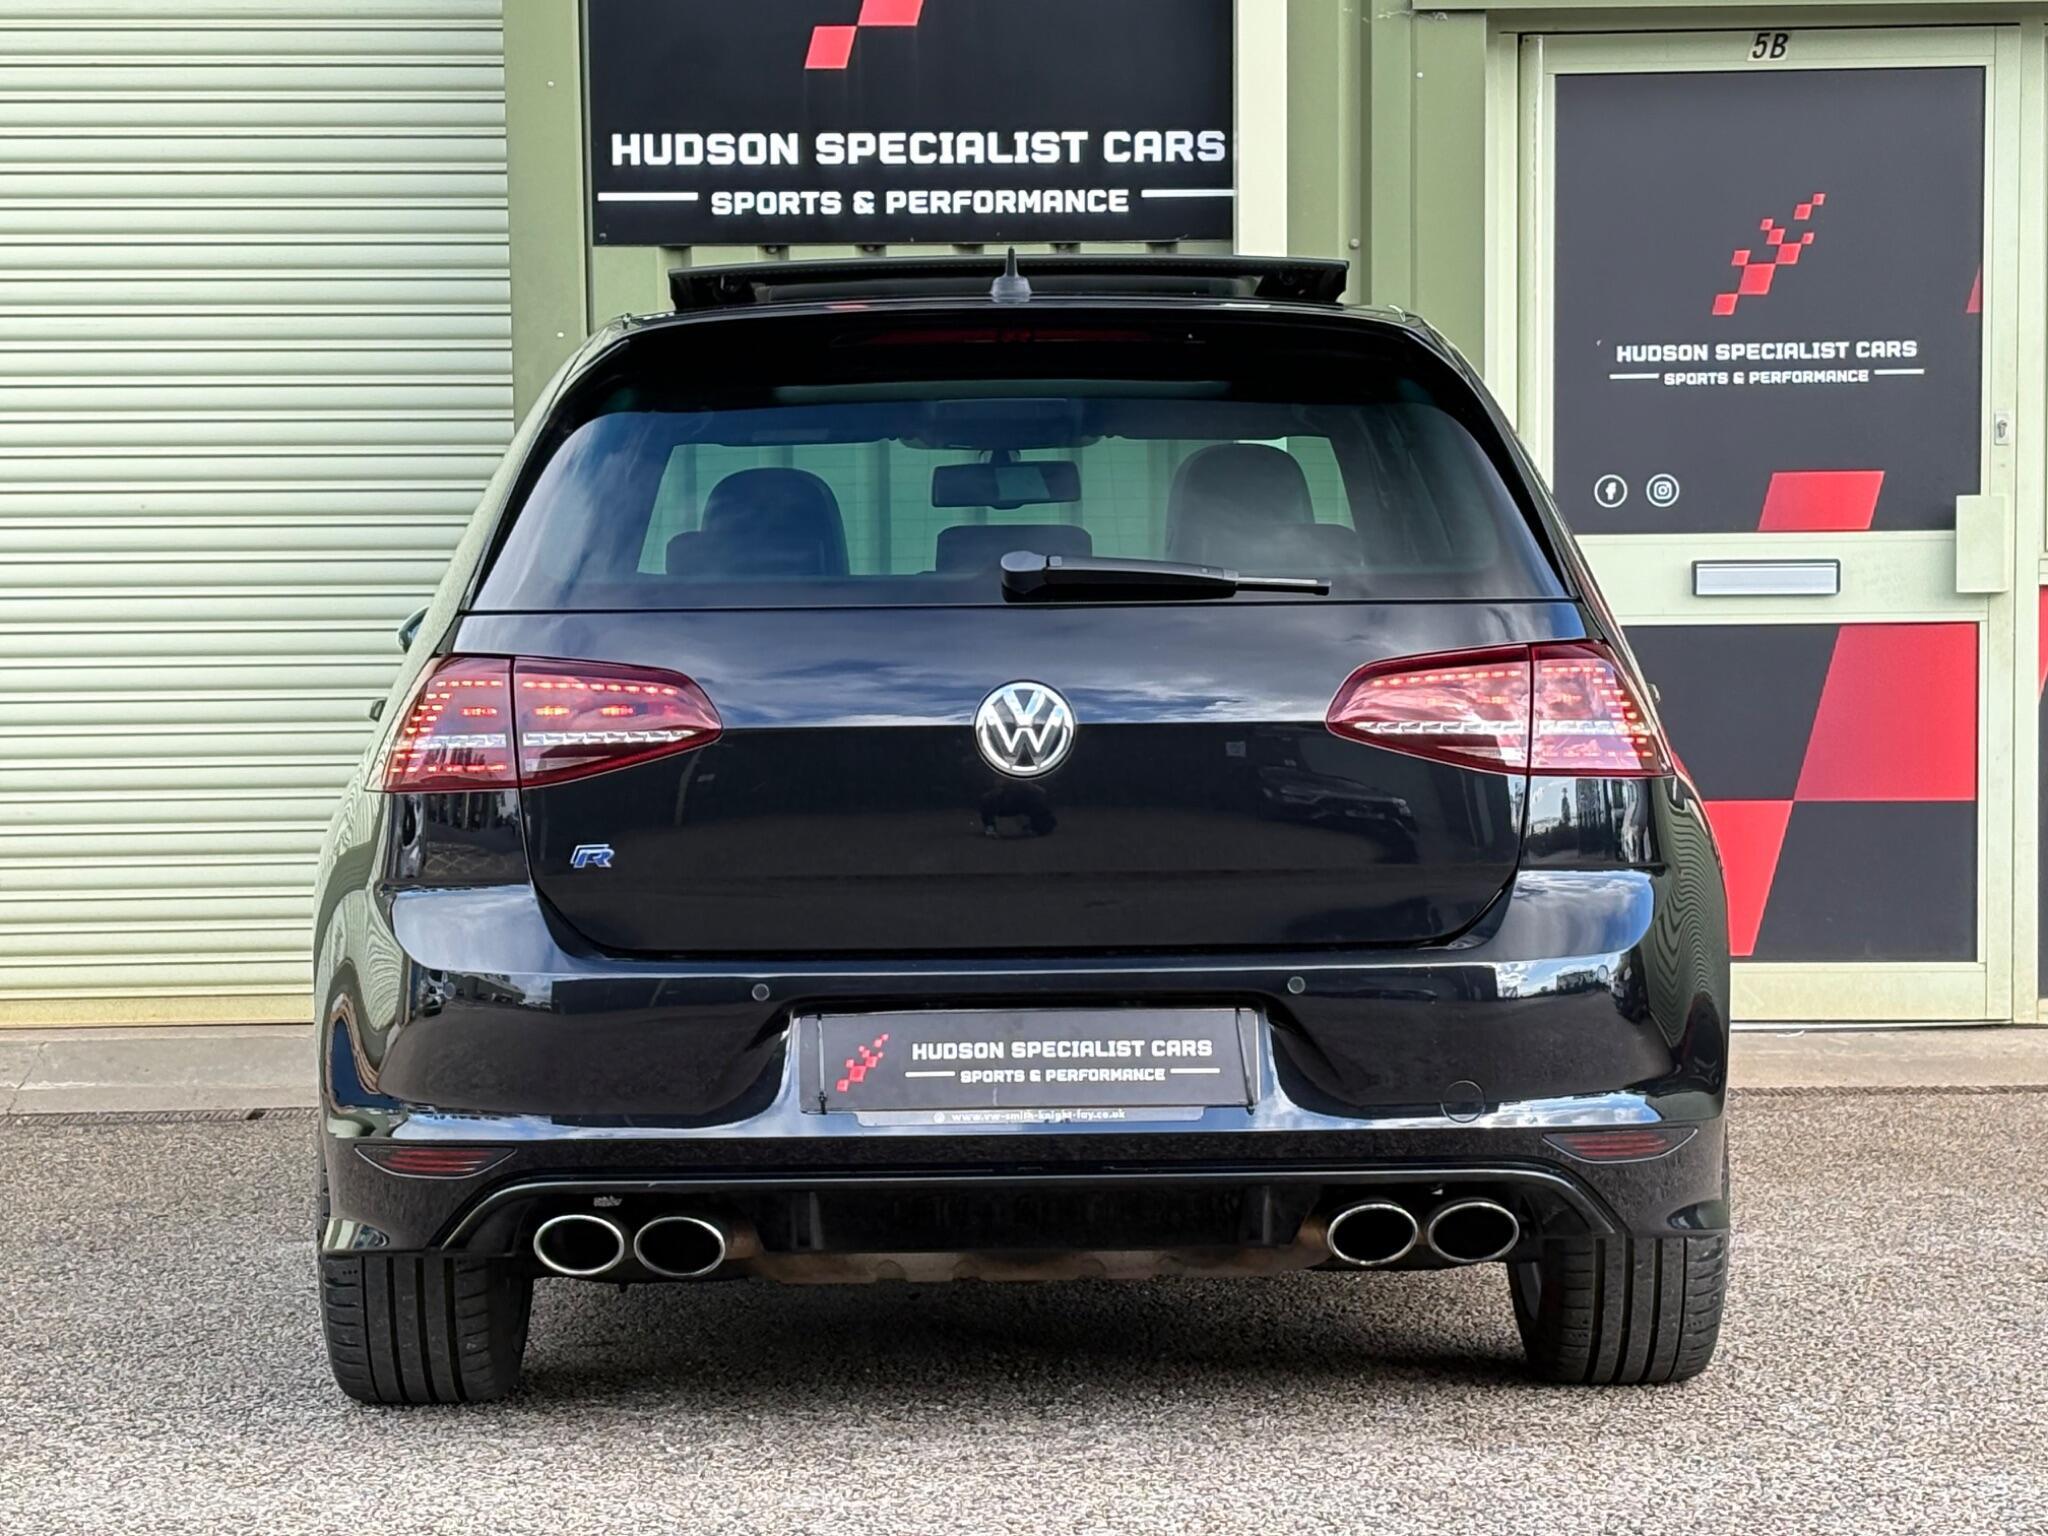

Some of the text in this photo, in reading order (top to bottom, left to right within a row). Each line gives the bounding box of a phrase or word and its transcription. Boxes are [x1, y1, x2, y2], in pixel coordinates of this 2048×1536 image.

[1752, 32, 1788, 58] 5B
[611, 130, 1226, 166] HUDSON SPECIALIST CARS
[711, 189, 1130, 216] SPORTS & PERFORMANCE
[1616, 340, 1918, 363] HUDSON SPECIALIST CARS
[1663, 369, 1870, 386] SPORTS & PERFORMANCE
[912, 1039, 1214, 1061] HUDSON SPECIALIST CARS
[960, 1067, 1166, 1084] SPORTS & PERFORMANCE
